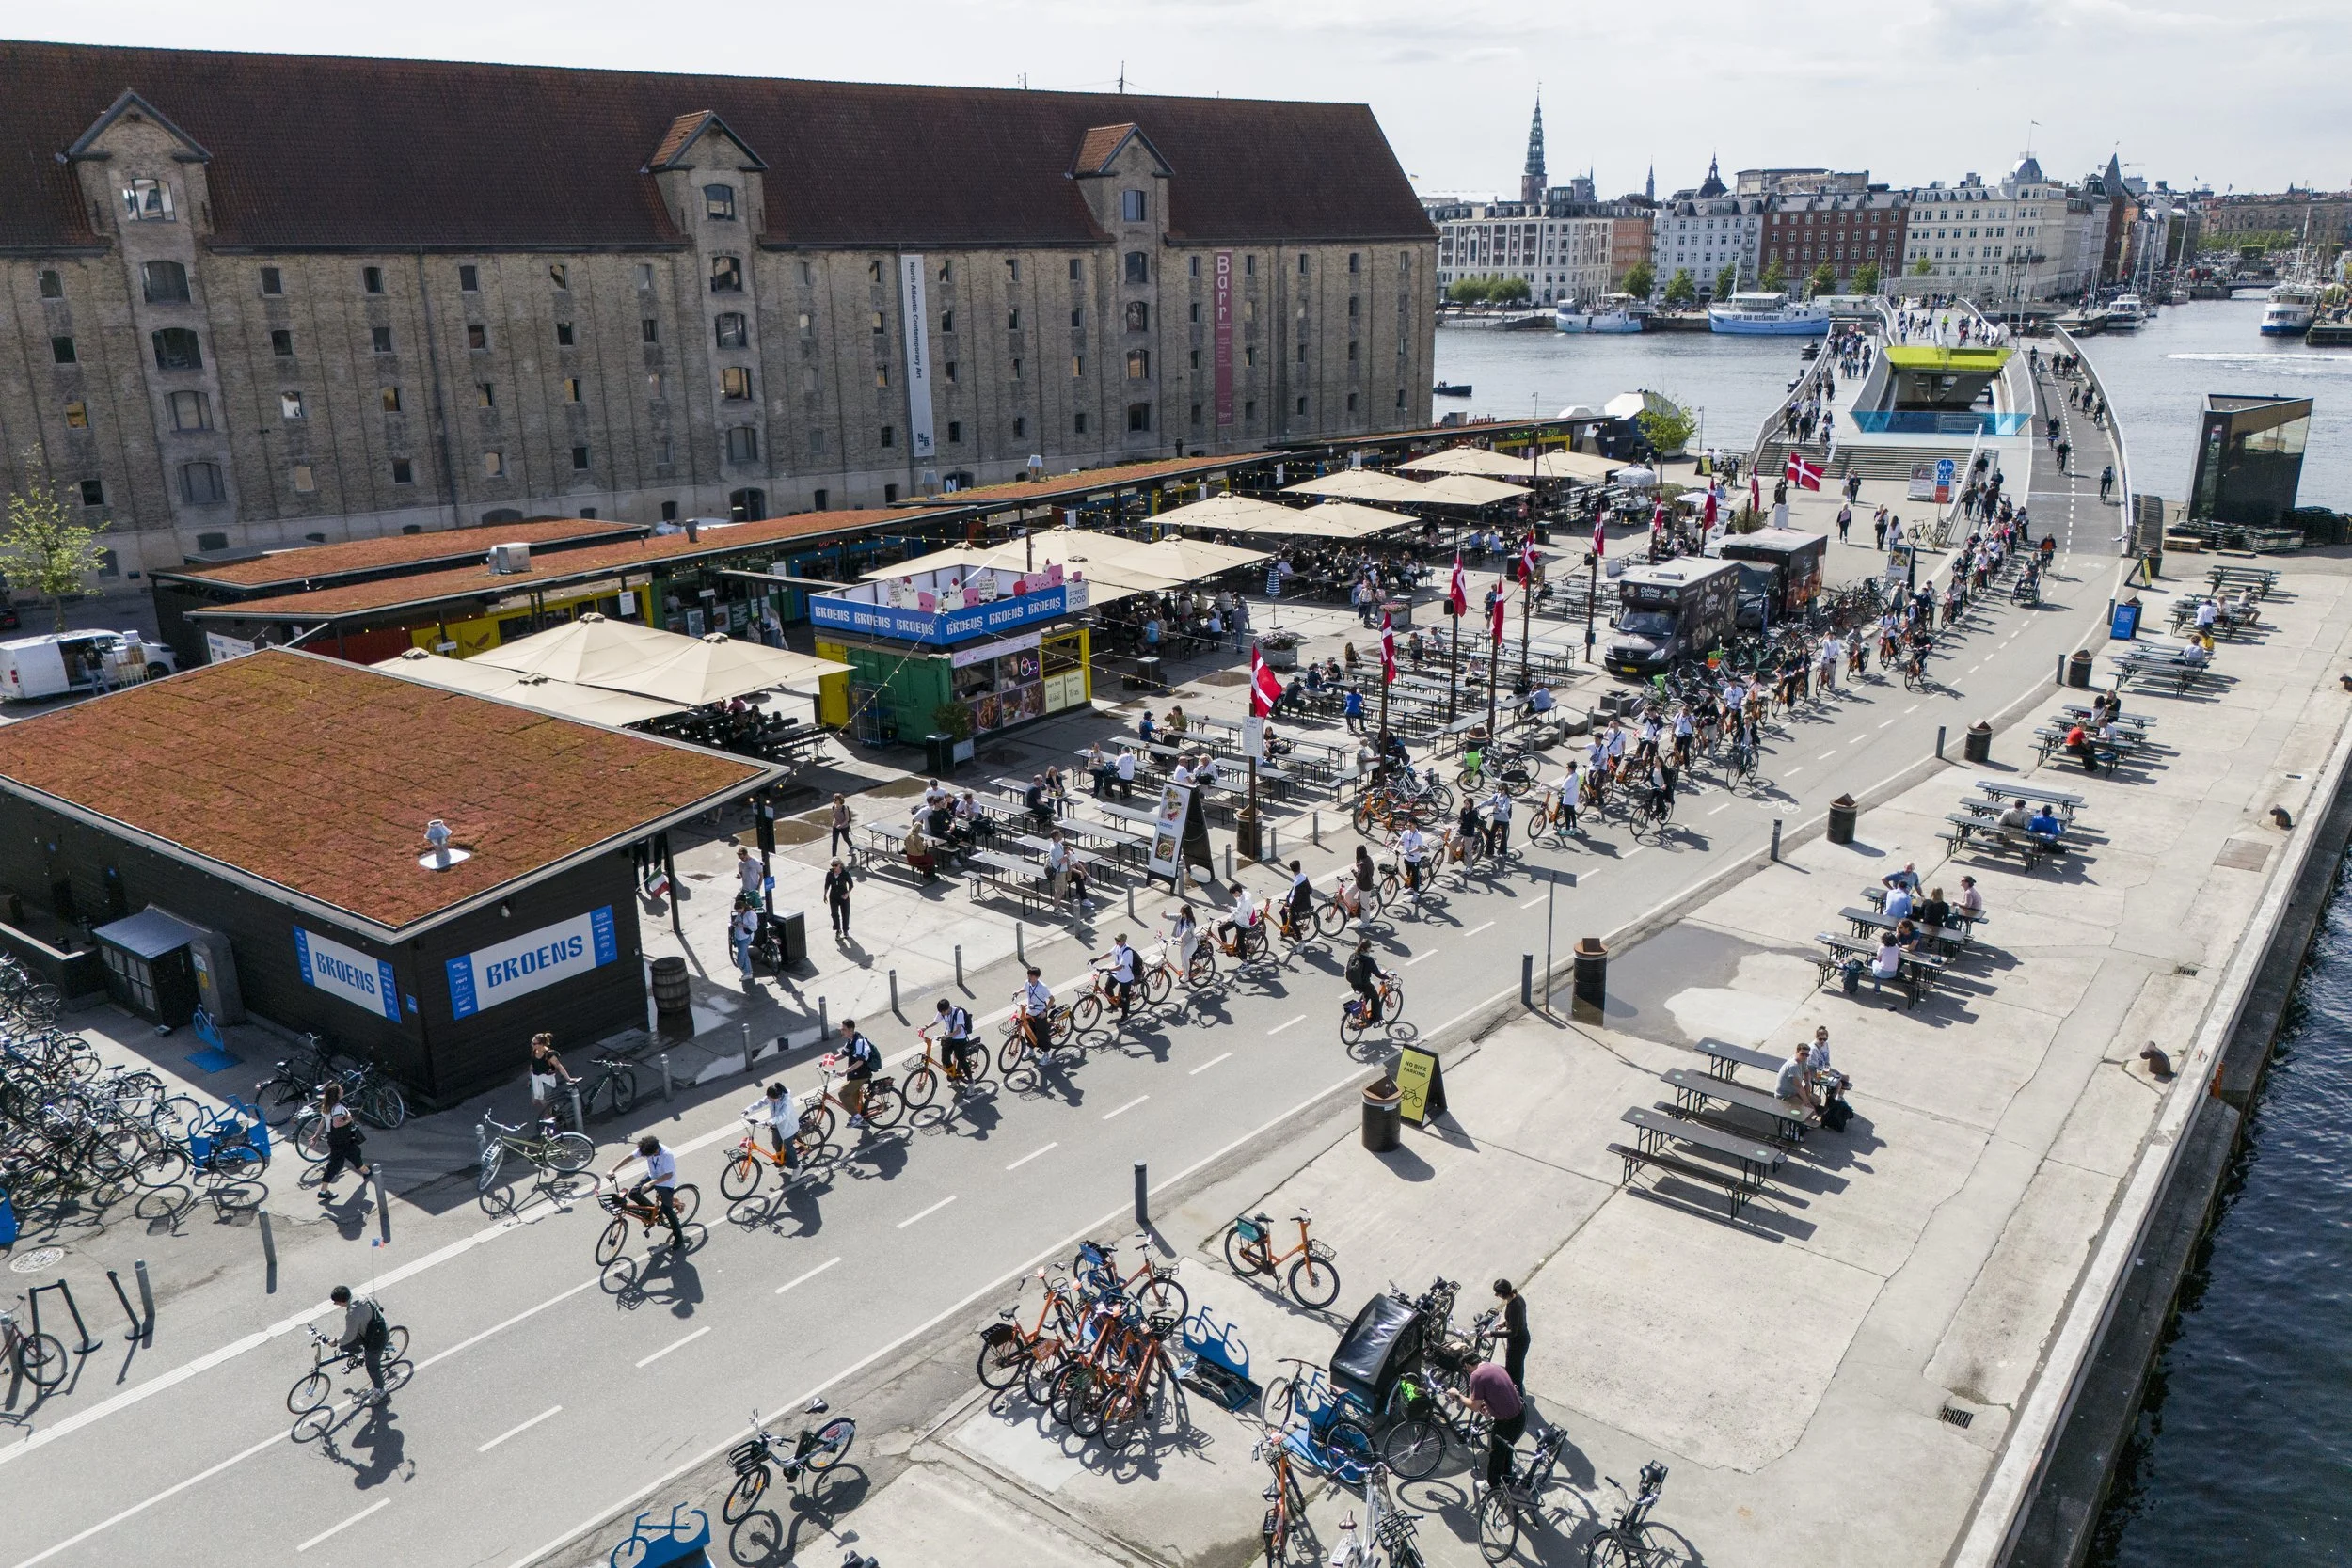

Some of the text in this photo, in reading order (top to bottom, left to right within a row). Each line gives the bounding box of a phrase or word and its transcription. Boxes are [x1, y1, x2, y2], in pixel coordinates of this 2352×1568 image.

[1216, 255, 1230, 321] Barr
[1069, 588, 1086, 596] STREET
[1069, 594, 1087, 605] FOOD
[815, 606, 935, 636] BROENS BROENS BROENS
[946, 596, 1062, 636] BROENS BROENS BROENS
[315, 951, 376, 996] BROENS
[485, 935, 583, 989] BROENS
[1403, 1067, 1426, 1078] PARKING
